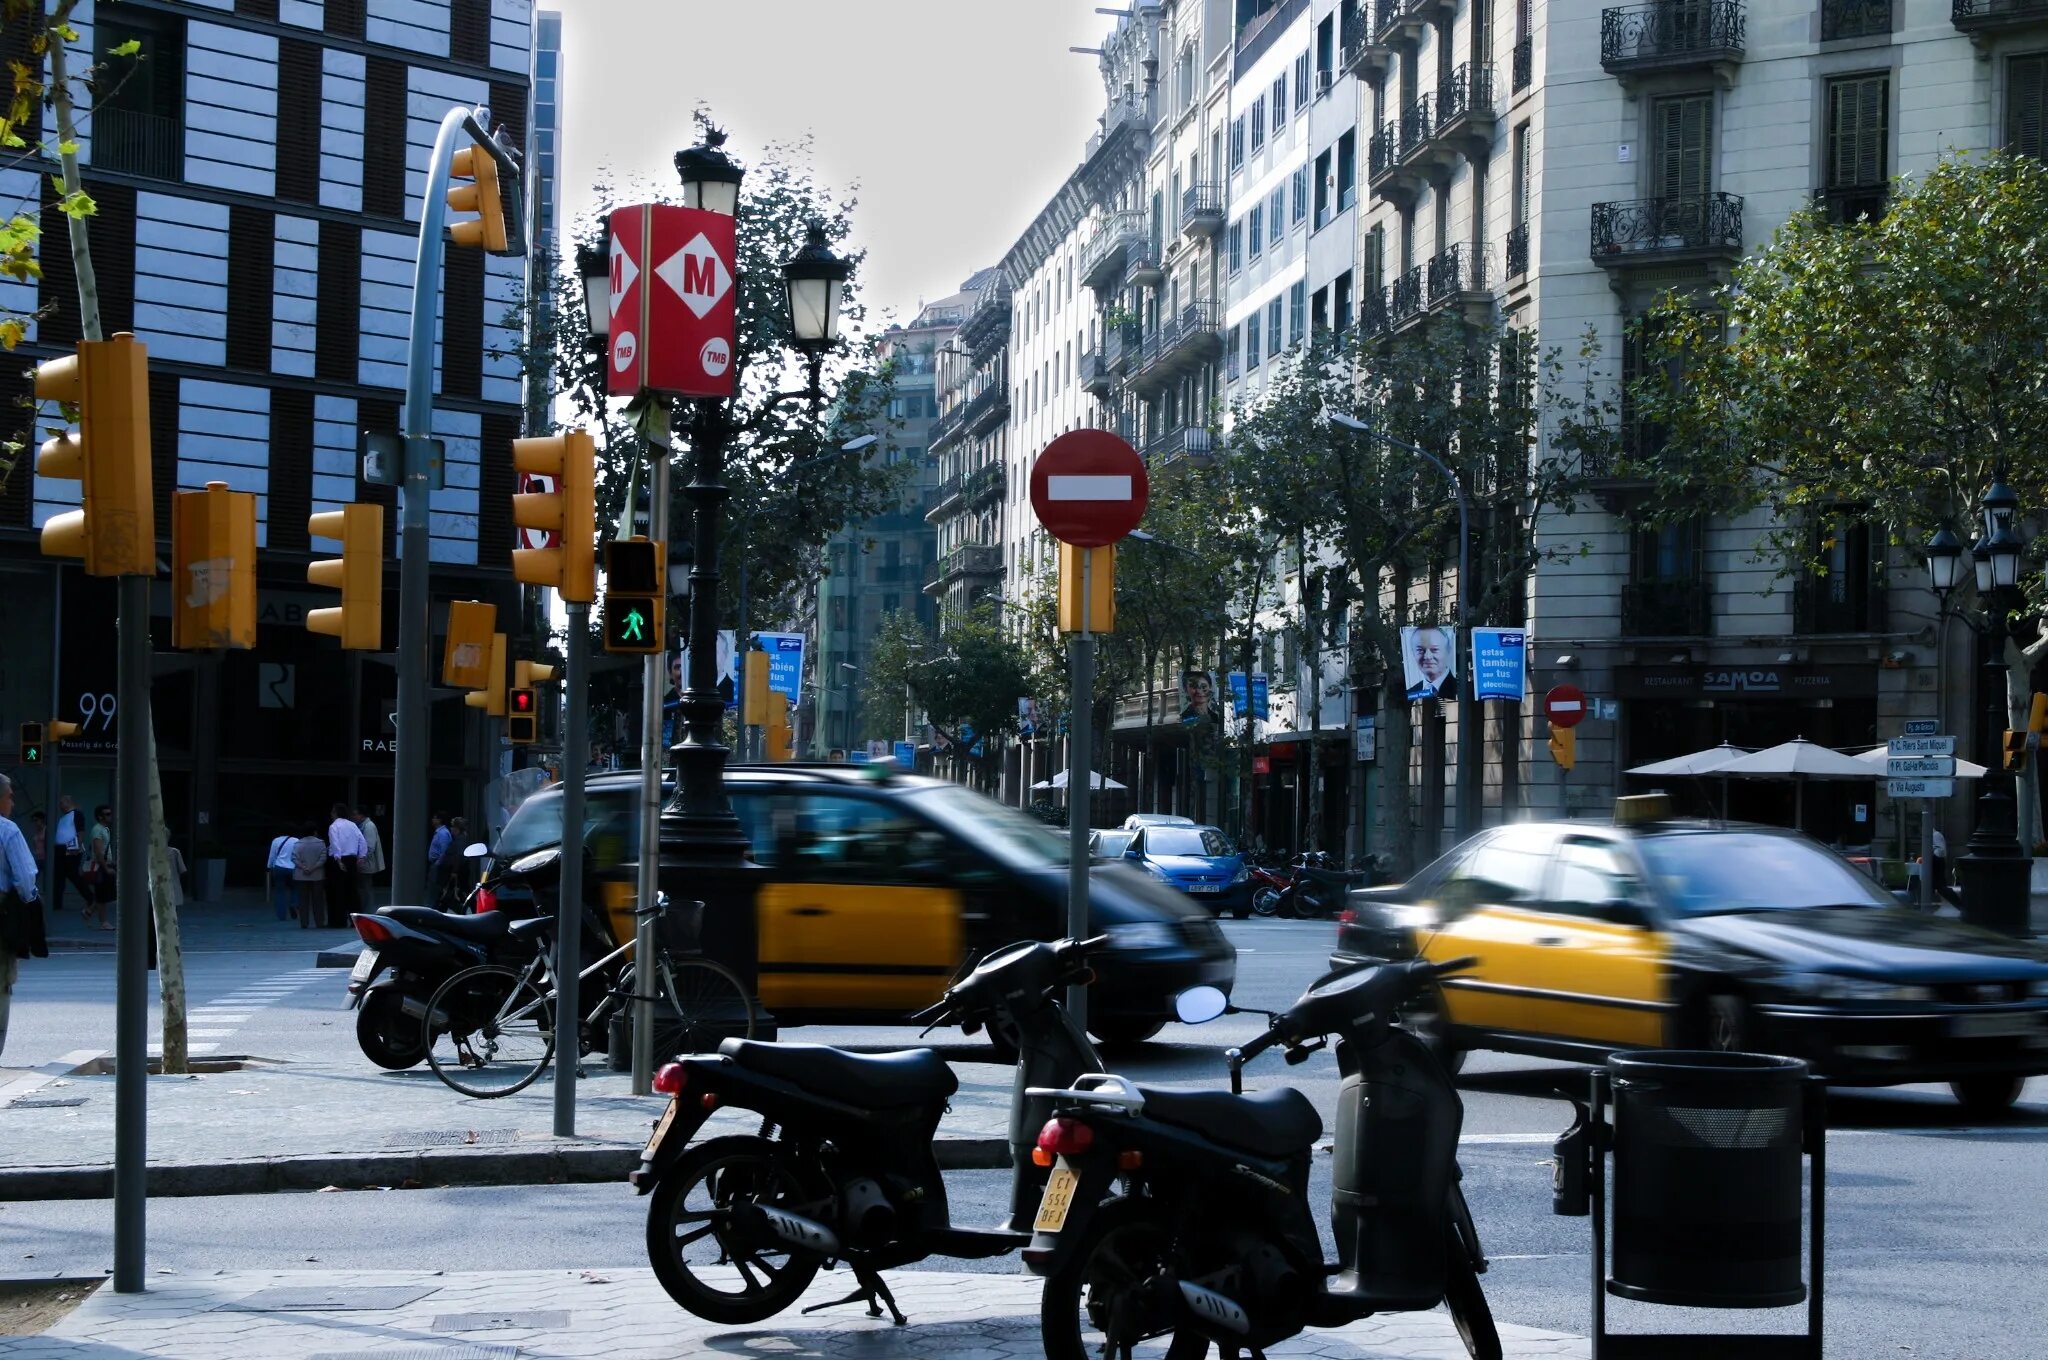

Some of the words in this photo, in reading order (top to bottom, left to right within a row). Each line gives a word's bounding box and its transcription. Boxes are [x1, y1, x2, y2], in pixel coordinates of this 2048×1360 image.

[609, 253, 622, 296] M
[683, 253, 715, 297] M
[616, 346, 632, 359] TMB
[707, 351, 727, 364] TMB
[1496, 669, 1511, 679] tus
[1643, 676, 1697, 687] RESTAURANT
[1703, 671, 1780, 691] SAMOA
[1792, 675, 1833, 686] PIZZERIA
[80, 692, 116, 731] 99
[1896, 782, 1904, 792] Via
[1905, 782, 1925, 794] Augusta
